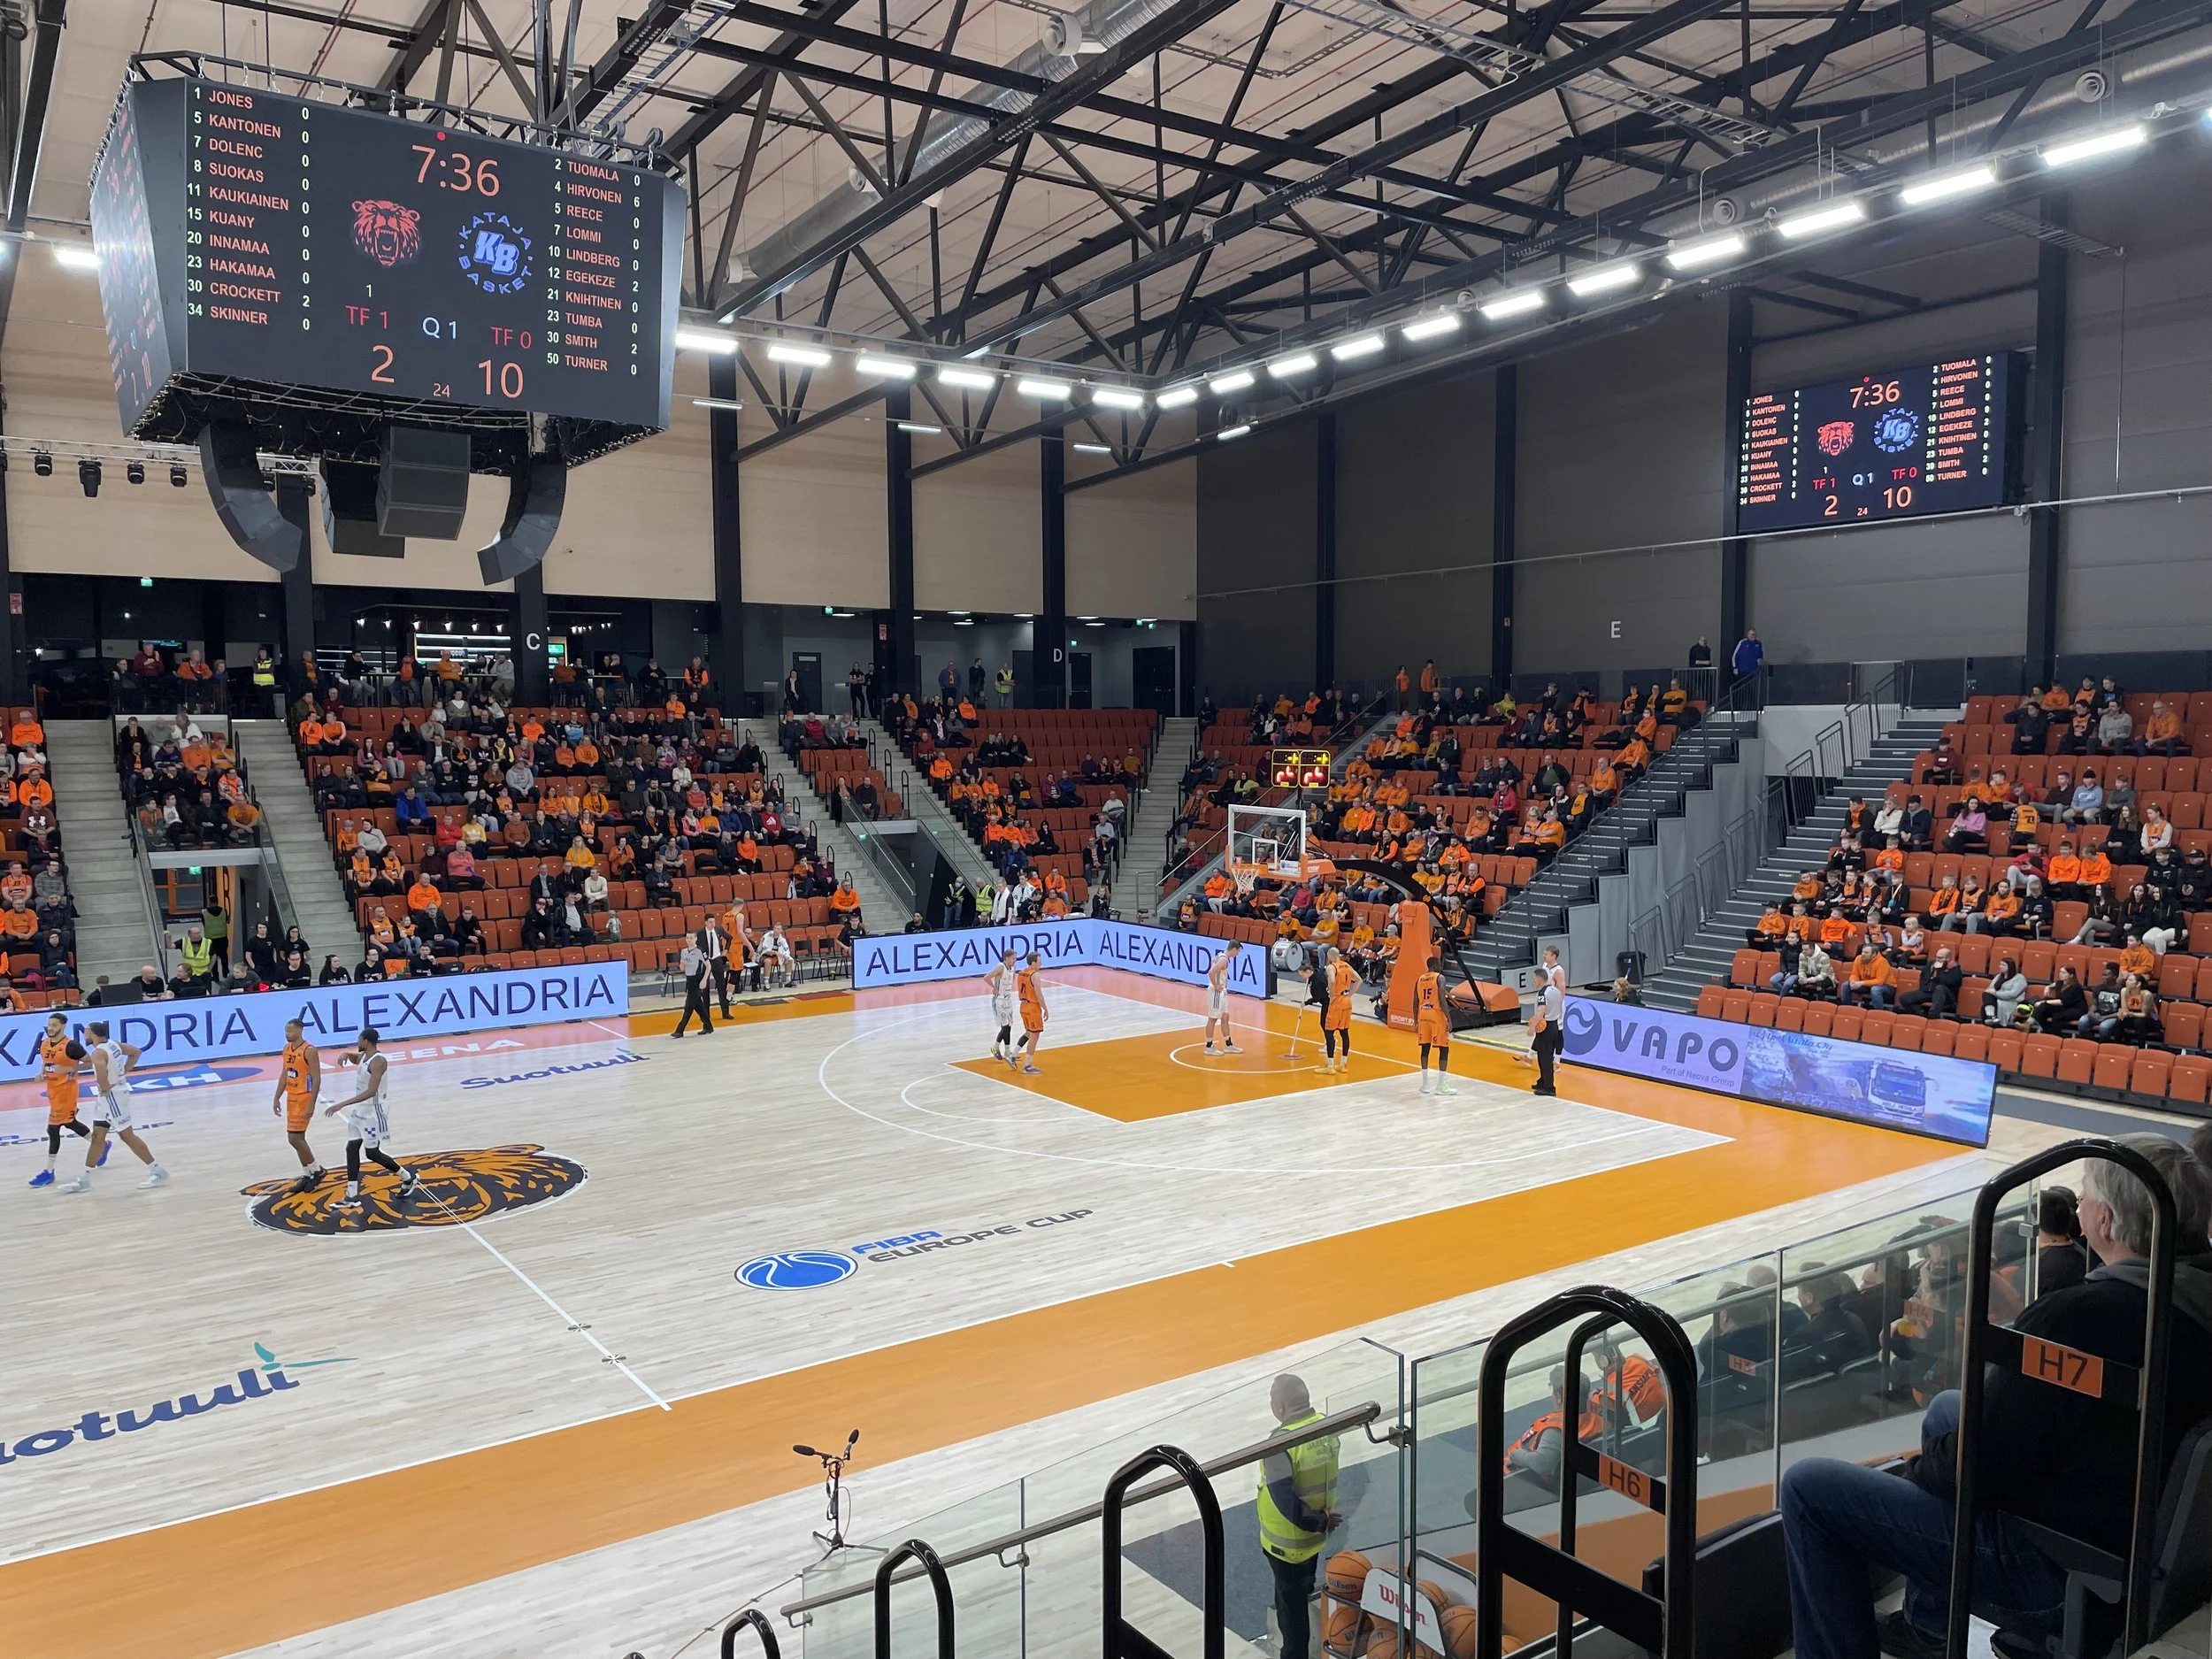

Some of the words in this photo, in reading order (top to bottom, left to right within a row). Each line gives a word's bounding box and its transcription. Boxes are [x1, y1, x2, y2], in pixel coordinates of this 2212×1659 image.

[195, 88, 201, 99] 1
[209, 90, 252, 108] JONES
[303, 108, 309, 119] 0
[195, 111, 202, 123] 5
[210, 114, 280, 138] KANTONEN
[303, 131, 309, 143] 0
[195, 135, 201, 147] 7
[210, 138, 262, 157] DOLENC
[303, 155, 309, 166] 0
[195, 159, 202, 172] 8
[210, 163, 263, 182] SUOKAS
[303, 179, 309, 190] 0
[412, 145, 499, 196] 7:36
[556, 158, 561, 170] 2
[568, 161, 618, 181] TUOMALA
[634, 175, 640, 186] 0
[188, 184, 201, 196] 11
[210, 187, 288, 211] KAUKIAINEN
[303, 202, 309, 214] 0
[555, 180, 561, 192] 4
[568, 183, 621, 204] HIRVONEN
[634, 196, 640, 207] 6
[188, 207, 202, 220] 15
[211, 211, 254, 228] KUANY
[303, 226, 309, 237] 0
[555, 203, 561, 213] 5
[567, 205, 603, 221] REECE
[634, 218, 639, 228] 0
[188, 231, 202, 244] 20
[211, 234, 269, 255] INNAMAA
[303, 250, 310, 260] 0
[555, 225, 560, 235] 7
[567, 227, 600, 242] LOMMI
[634, 239, 639, 250] 0
[188, 255, 202, 268] 23
[211, 258, 275, 279] HAKAMAA
[303, 273, 310, 283] 0
[549, 245, 560, 257] 10
[566, 249, 619, 267] LINDBERG
[634, 260, 639, 271] 0
[366, 285, 371, 297] 1
[549, 267, 559, 279] 12
[566, 271, 615, 288] EGEKEZE
[633, 281, 638, 292] 2
[188, 279, 202, 292] 30
[211, 283, 280, 303] CROCKETT
[303, 296, 310, 307] 2
[548, 288, 558, 300] 21
[566, 291, 621, 310] KNIHTINEN
[633, 303, 638, 312] 0
[188, 303, 203, 316] 34
[211, 306, 267, 324] SKINNER
[303, 319, 310, 330] 0
[346, 306, 369, 326] TF
[380, 311, 387, 328] 1
[423, 318, 440, 338] Q
[449, 321, 456, 339] 1
[548, 310, 559, 321] 23
[565, 312, 602, 327] TUMBA
[632, 323, 637, 334] 0
[492, 327, 512, 345] TF
[520, 332, 531, 349] 0
[548, 331, 558, 343] 30
[565, 334, 596, 348] SMITH
[632, 343, 637, 354] 2
[372, 345, 394, 382] 2
[547, 353, 558, 364] 50
[565, 356, 607, 371] TURNER
[631, 365, 636, 375] 0
[1941, 359, 1976, 371] TUOMALA
[479, 360, 523, 397] 10
[1941, 371, 1978, 383] HIRVONEN
[434, 383, 449, 397] 24
[1850, 380, 1900, 408] 7:36
[1940, 385, 1964, 396] REECE
[1939, 408, 1976, 419] LINDBERG
[1940, 398, 1963, 408] LOMMI
[1939, 421, 1972, 432] EGEKEZE
[1939, 432, 1977, 444] KNIHTINEN
[1938, 459, 1960, 468] SMITH
[1939, 447, 1963, 457] TUMBA
[1813, 479, 1825, 489] TF
[1831, 478, 1835, 488] 1
[1853, 474, 1863, 486] Q
[1868, 472, 1872, 483] 1
[1892, 468, 1906, 480] TF
[1909, 467, 1916, 478] 0
[1938, 471, 1966, 480] TURNER
[1824, 495, 1837, 515] 2
[1884, 487, 1911, 508] 10
[1609, 620, 1621, 639] E
[526, 634, 541, 650] C
[1053, 648, 1063, 662] D
[865, 929, 1085, 977] ALEXANDRIA
[297, 972, 616, 1034] ALEXANDRIA
[1423, 987, 1432, 1000] 15
[1611, 1018, 1740, 1072] VAPO
[459, 1049, 650, 1089] Suotuuli
[1661, 1064, 1676, 1075] Part
[1711, 1075, 1734, 1087] Group
[851, 1231, 943, 1255] FIBA
[867, 1225, 1022, 1263] EUROPE
[1025, 1209, 1094, 1228] CUP
[2039, 1344, 2088, 1386] H7
[1609, 1461, 1640, 1498] H6
